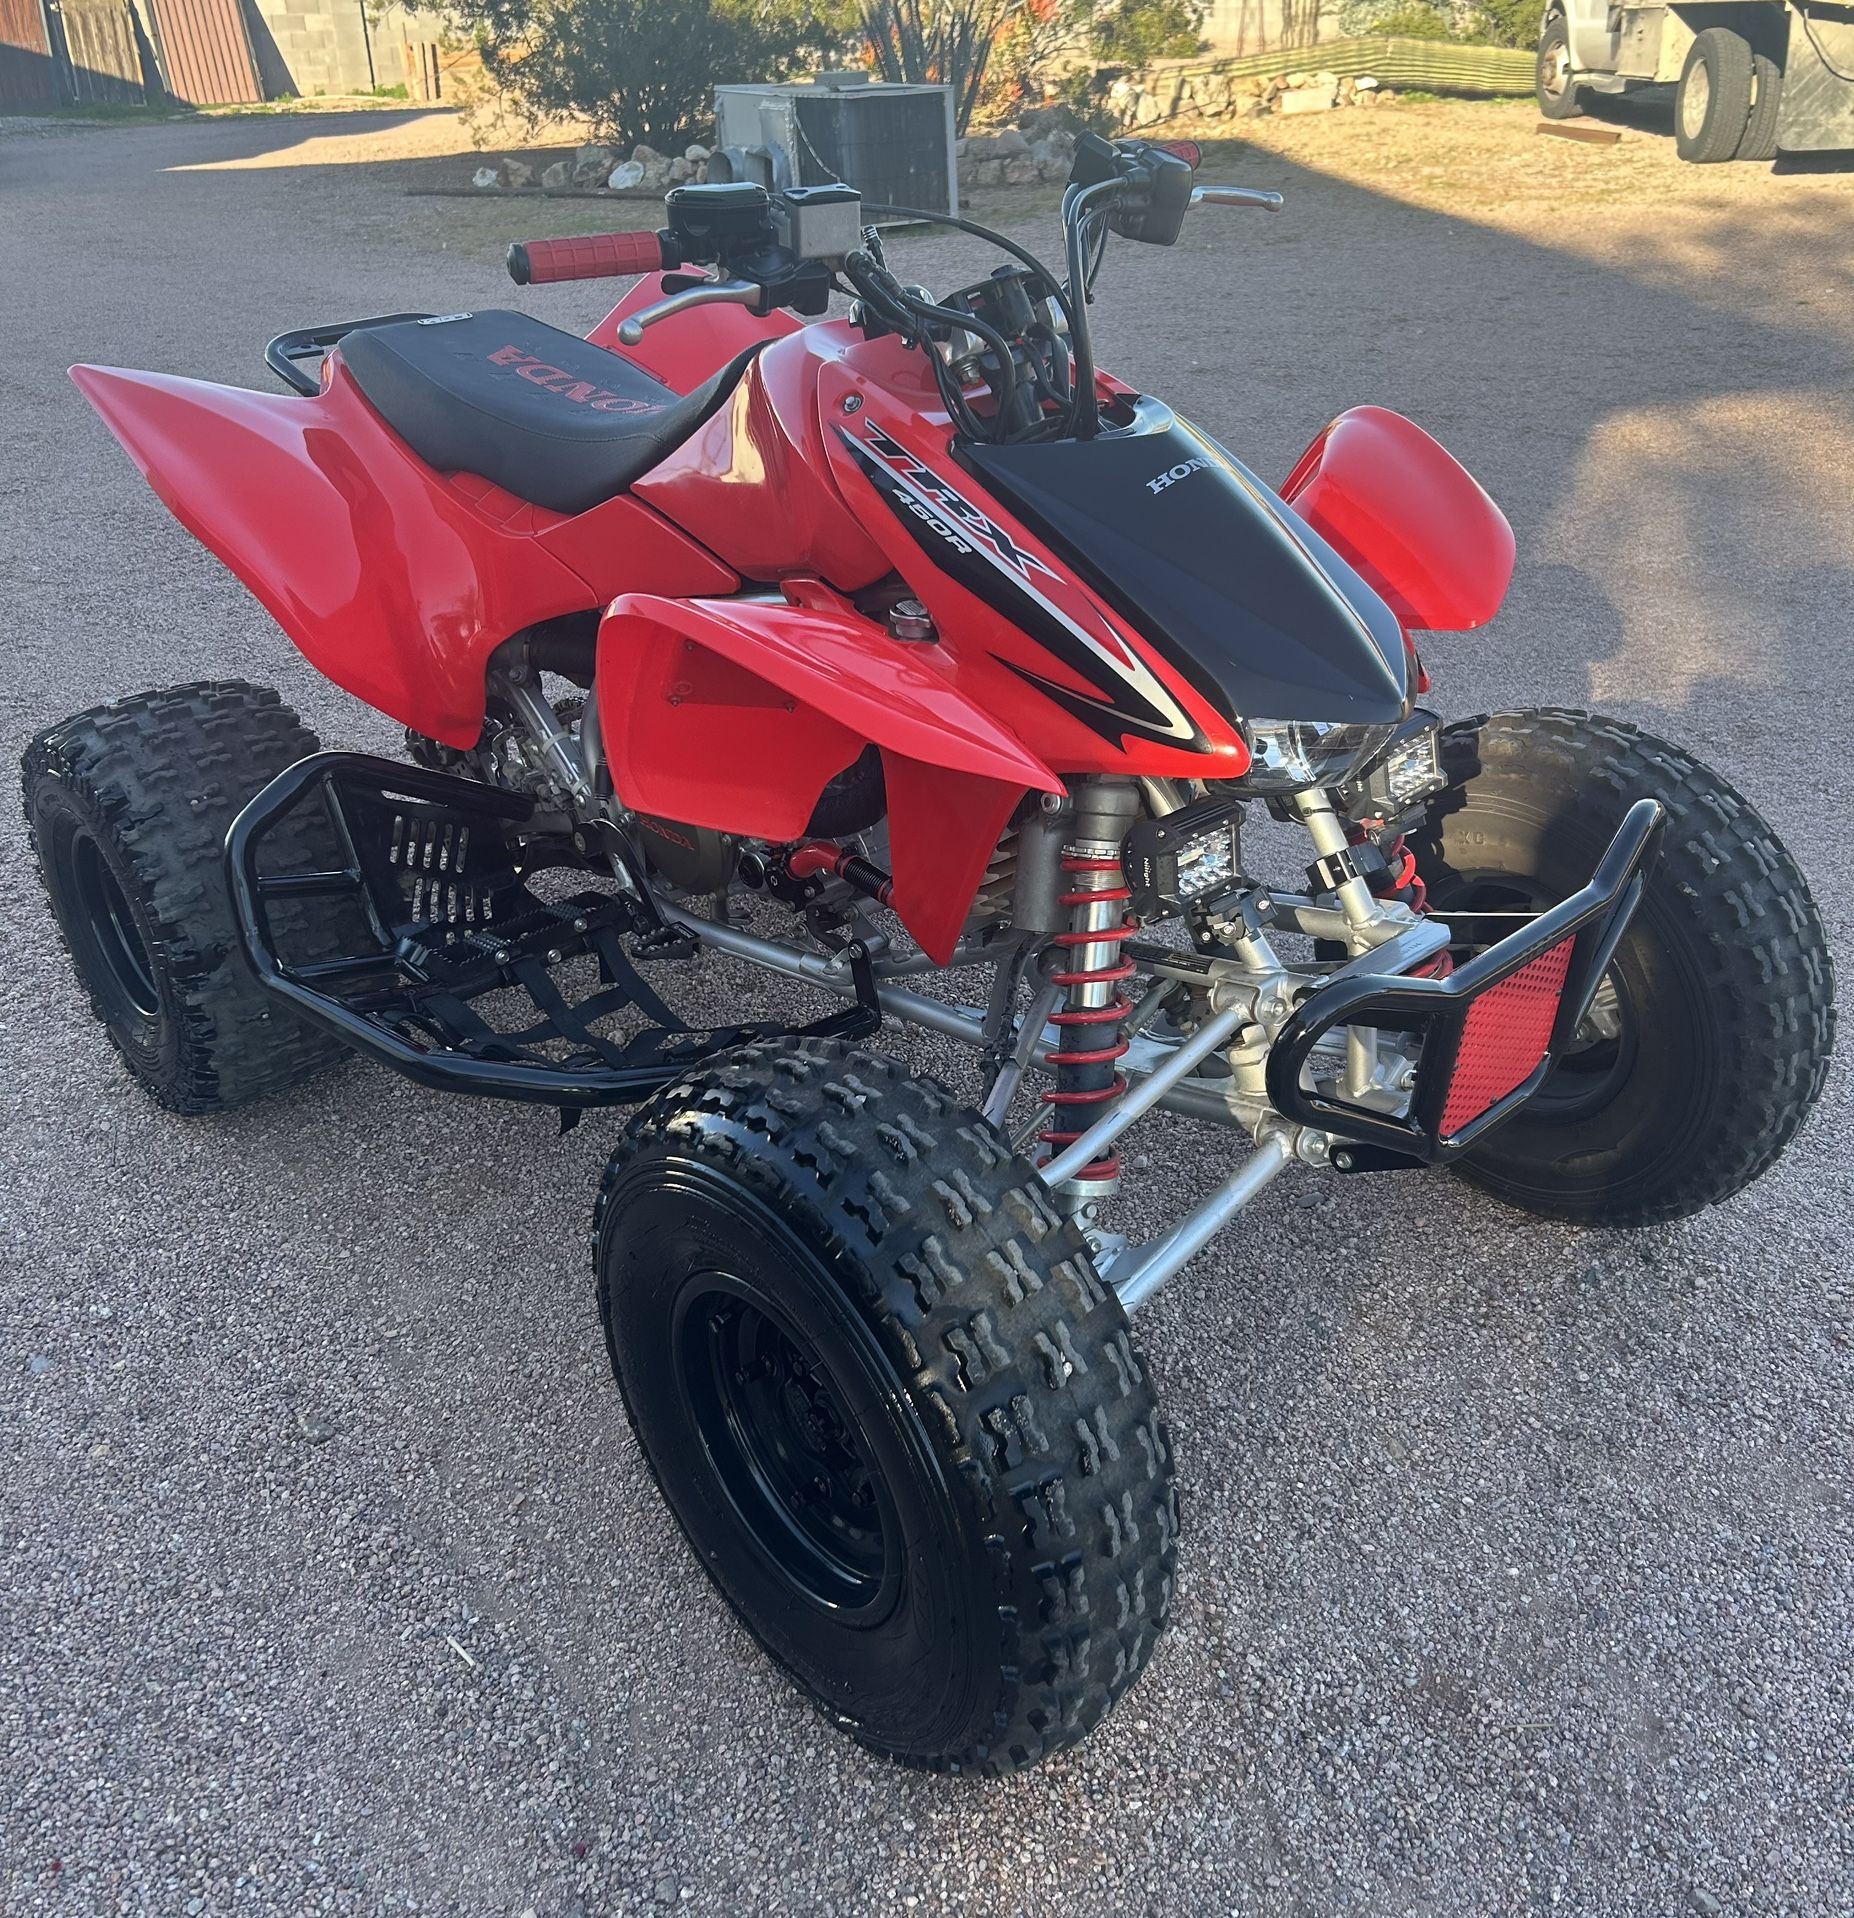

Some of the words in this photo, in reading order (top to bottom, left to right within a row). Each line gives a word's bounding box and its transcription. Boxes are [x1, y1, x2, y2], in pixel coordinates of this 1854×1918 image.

[864, 416, 1068, 586] TRX
[1146, 457, 1224, 495] HOND
[892, 488, 972, 554] 450R
[1143, 857, 1151, 888] Nilight
